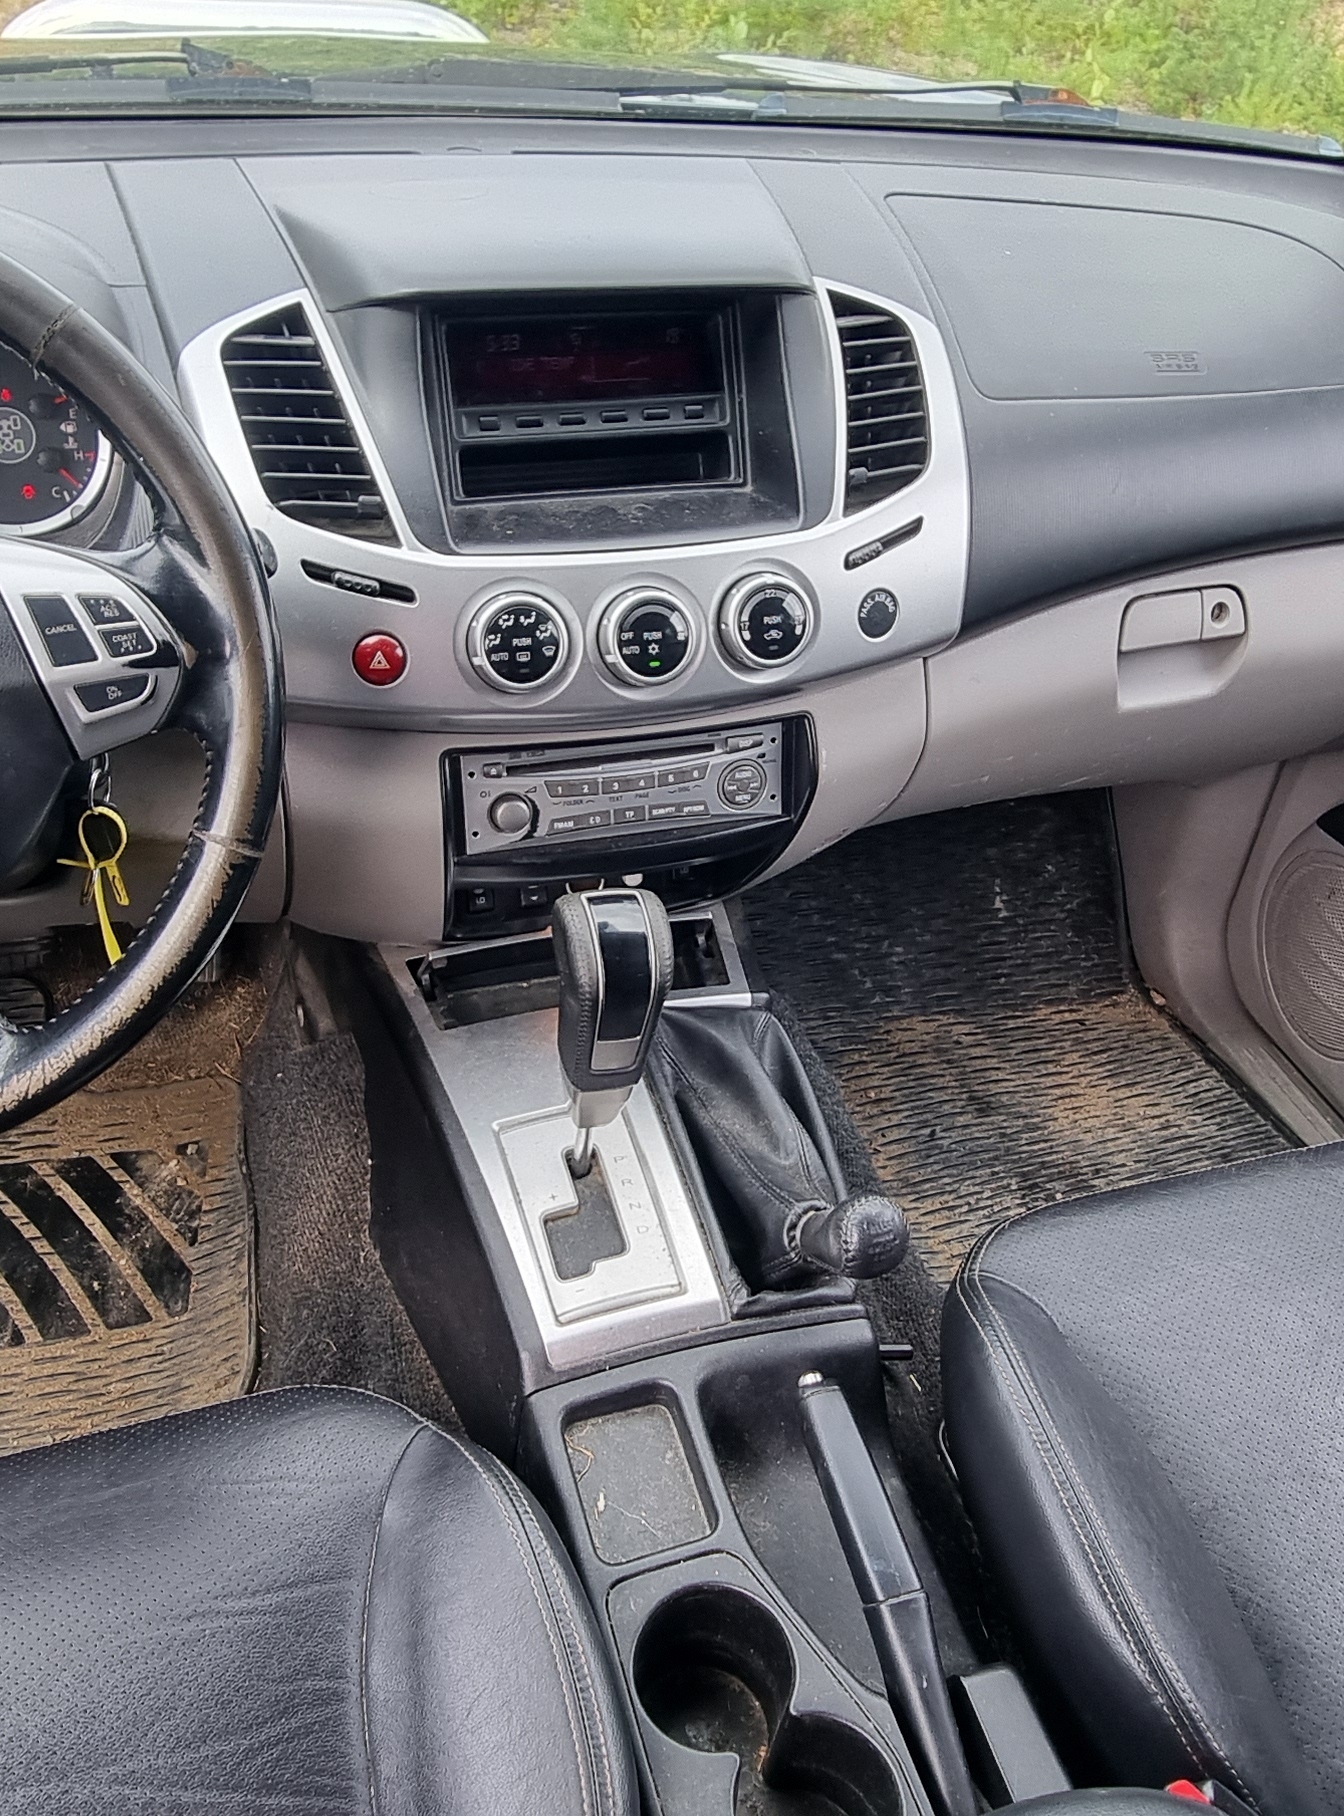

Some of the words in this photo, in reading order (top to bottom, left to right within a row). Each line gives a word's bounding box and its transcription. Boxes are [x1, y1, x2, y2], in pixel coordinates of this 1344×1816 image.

[69, 408, 76, 419] E
[73, 450, 84, 461] H
[51, 486, 61, 498] C
[45, 623, 77, 635] CANCEL
[112, 632, 137, 643] COAST
[621, 631, 634, 641] OFF
[512, 637, 532, 647] PUSH
[622, 645, 640, 655] AUTO
[491, 652, 509, 661] AUTO
[668, 774, 674, 782] 5
[692, 770, 699, 778] 6
[612, 782, 619, 790] 3
[639, 779, 645, 787] 4
[558, 786, 563, 794] 1
[582, 785, 589, 793] 2
[625, 811, 635, 819] TP
[589, 816, 601, 825] CD
[621, 1178, 633, 1186] R
[629, 1201, 641, 1210] N
[636, 1225, 649, 1234] D
